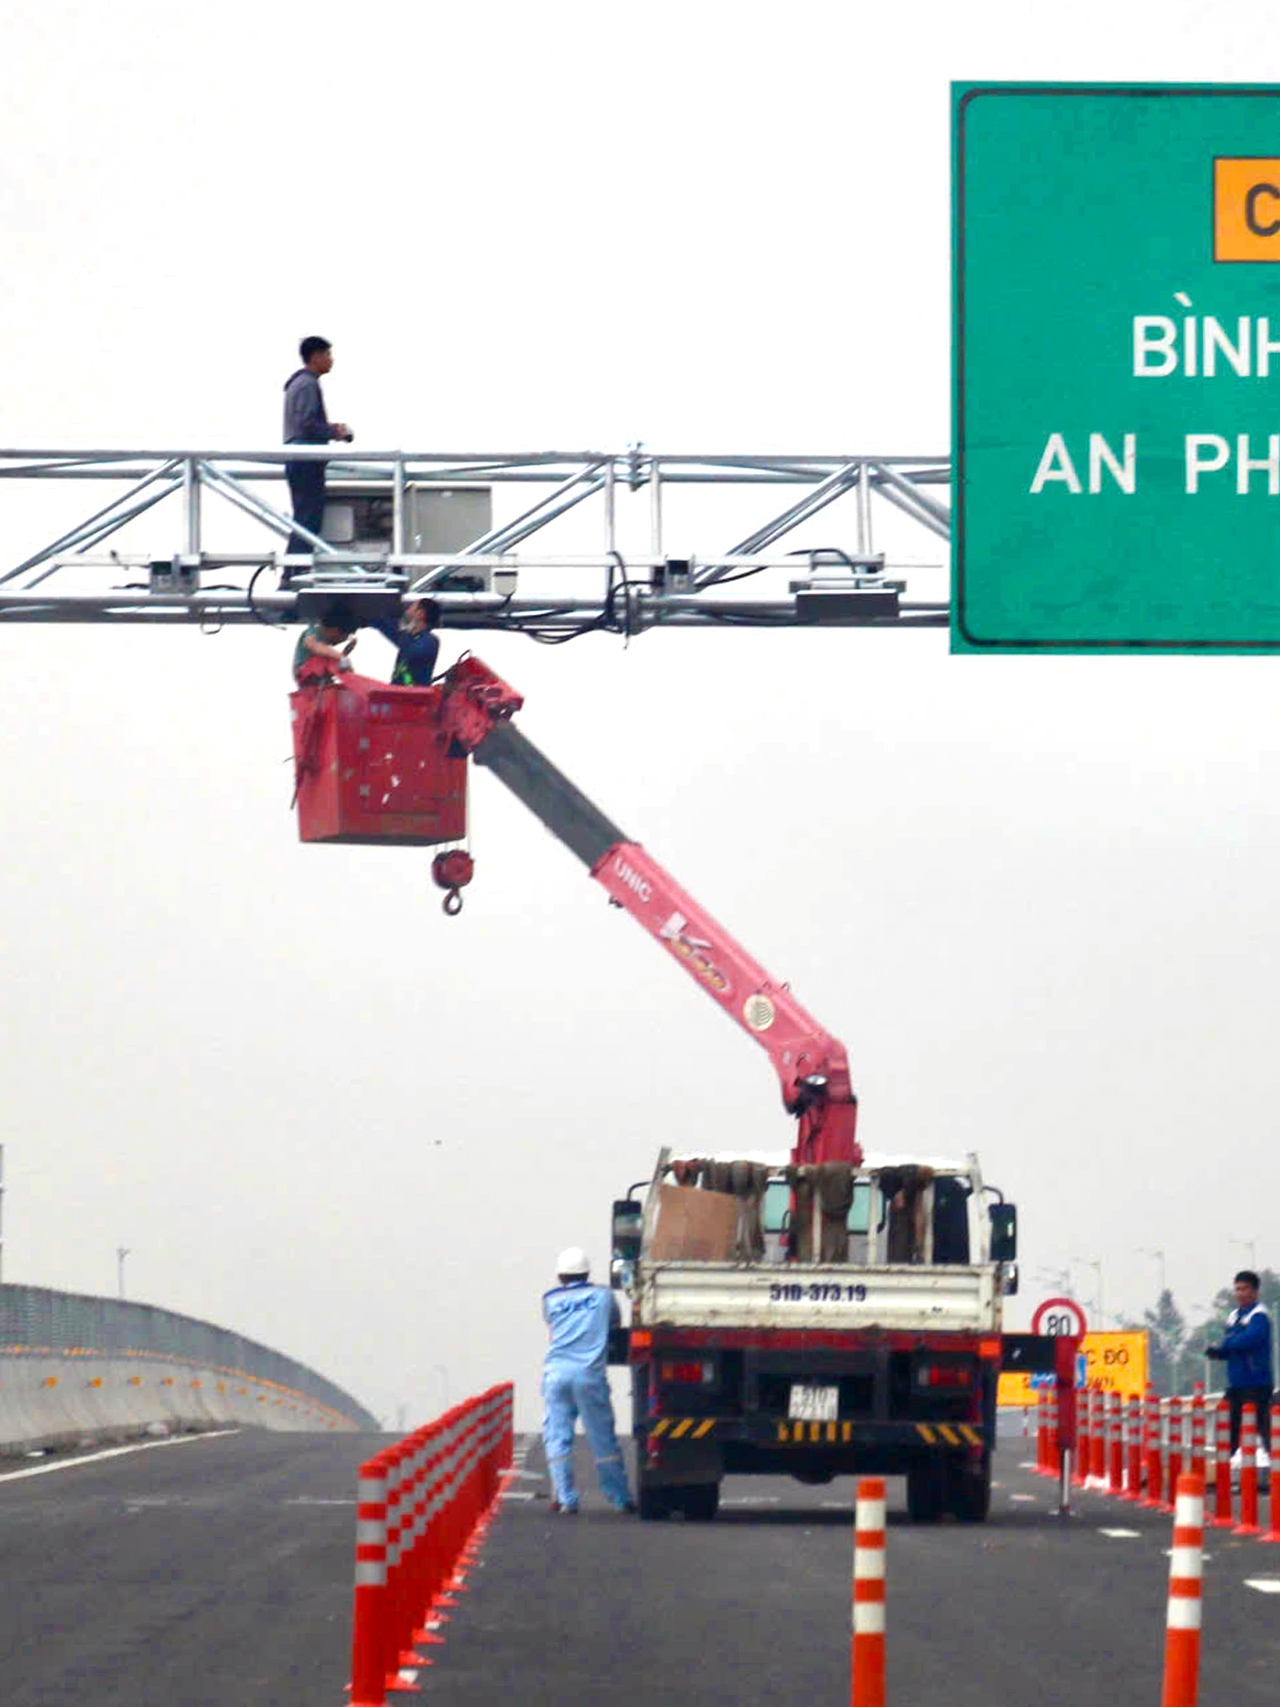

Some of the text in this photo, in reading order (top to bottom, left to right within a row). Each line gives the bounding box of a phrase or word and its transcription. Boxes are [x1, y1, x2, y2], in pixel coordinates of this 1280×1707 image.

[1030, 433, 1136, 494] AN
[614, 856, 652, 904] UNIC
[1047, 1314, 1071, 1337] 80
